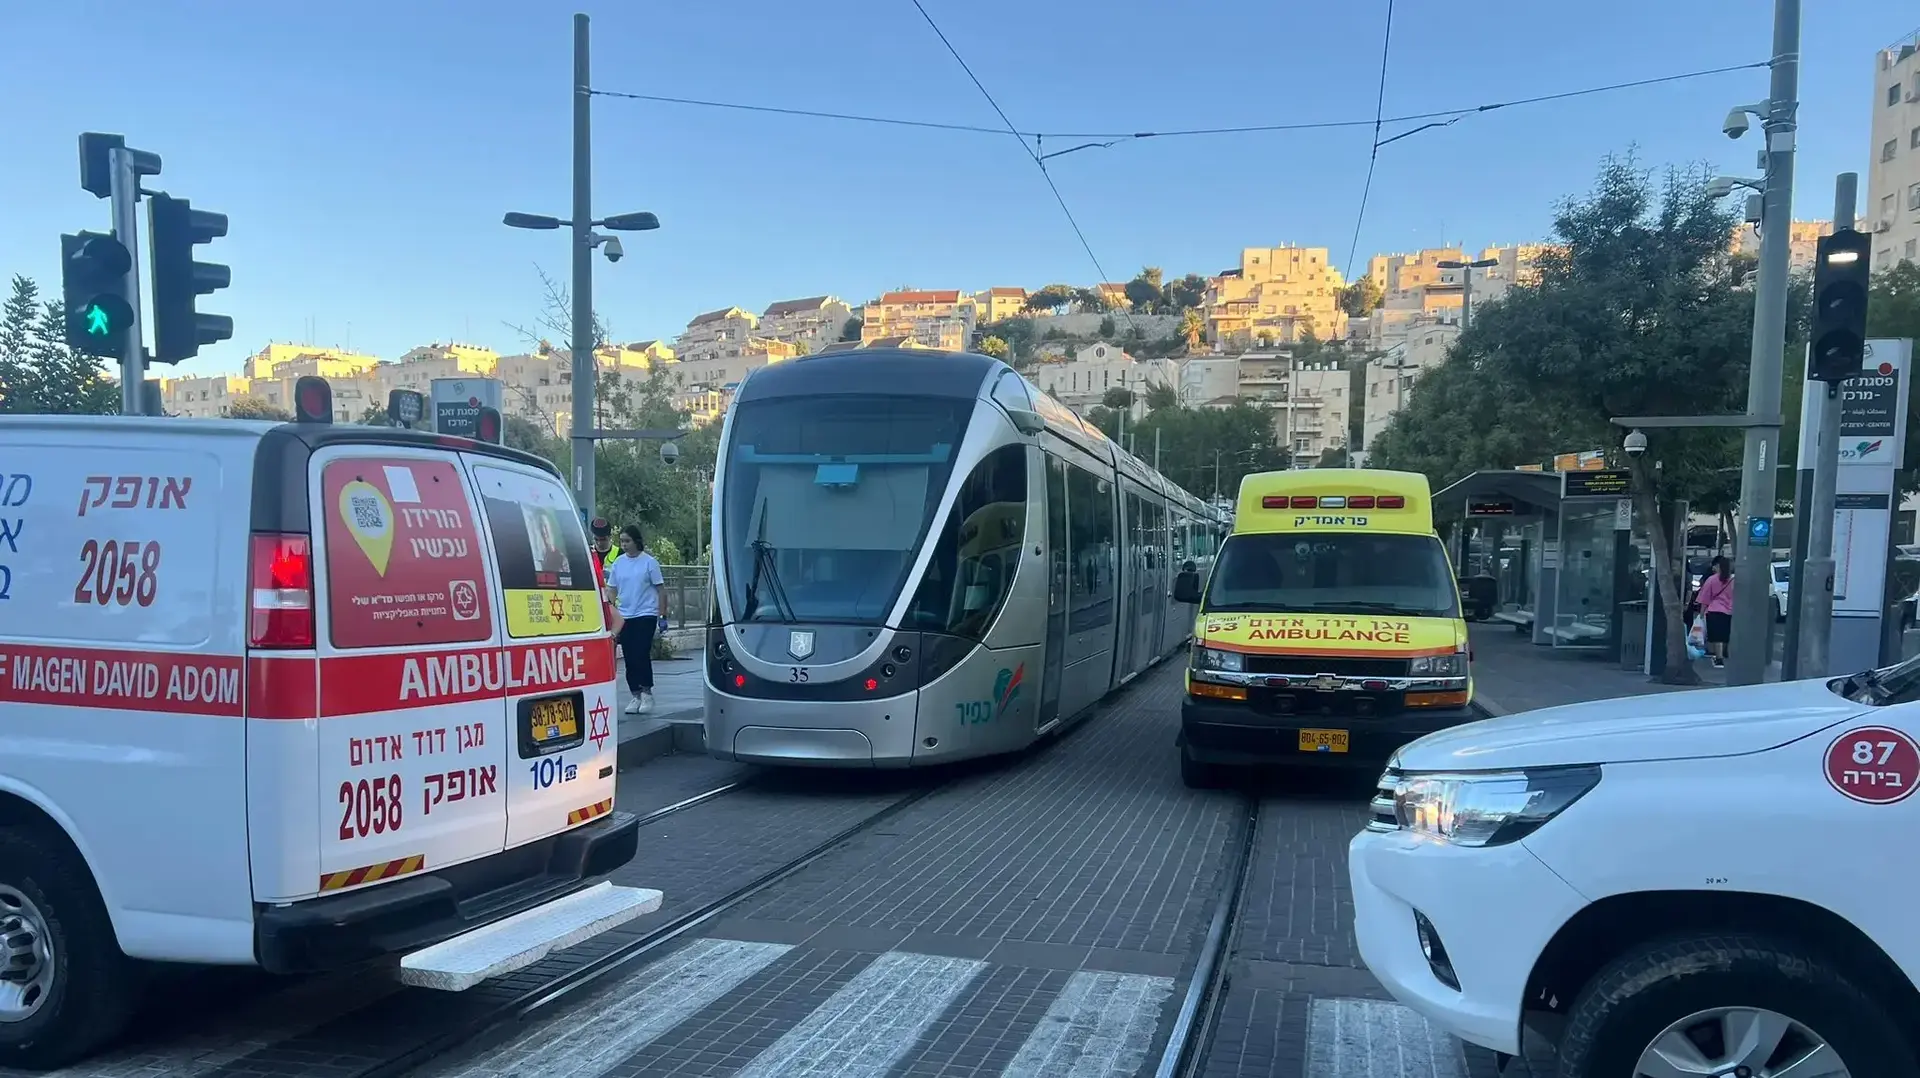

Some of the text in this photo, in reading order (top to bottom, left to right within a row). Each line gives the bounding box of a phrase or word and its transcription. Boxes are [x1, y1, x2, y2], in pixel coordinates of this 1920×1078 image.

[1858, 377, 1894, 386] פסגת
[78, 476, 192, 517] אופק
[401, 508, 462, 529] הורידו
[1294, 516, 1368, 528] פראמדיק
[410, 538, 468, 558] עכשיו
[74, 539, 161, 607] 2058
[1207, 622, 1238, 632] 53
[1249, 628, 1410, 644] AMBULANCE
[1250, 618, 1410, 631] מגן דוד אדום
[12, 655, 87, 694] MAGEN
[93, 660, 159, 699] DAVID
[166, 664, 239, 704] ADOM
[400, 645, 586, 701] AMBULANCE
[789, 667, 808, 683] 35
[955, 701, 991, 726] כפיר
[350, 722, 484, 766] מגן דוד אדום
[1852, 740, 1897, 766] 87
[530, 755, 563, 790] 101
[1843, 770, 1902, 787] בירה
[339, 764, 496, 840] אופק 2058
